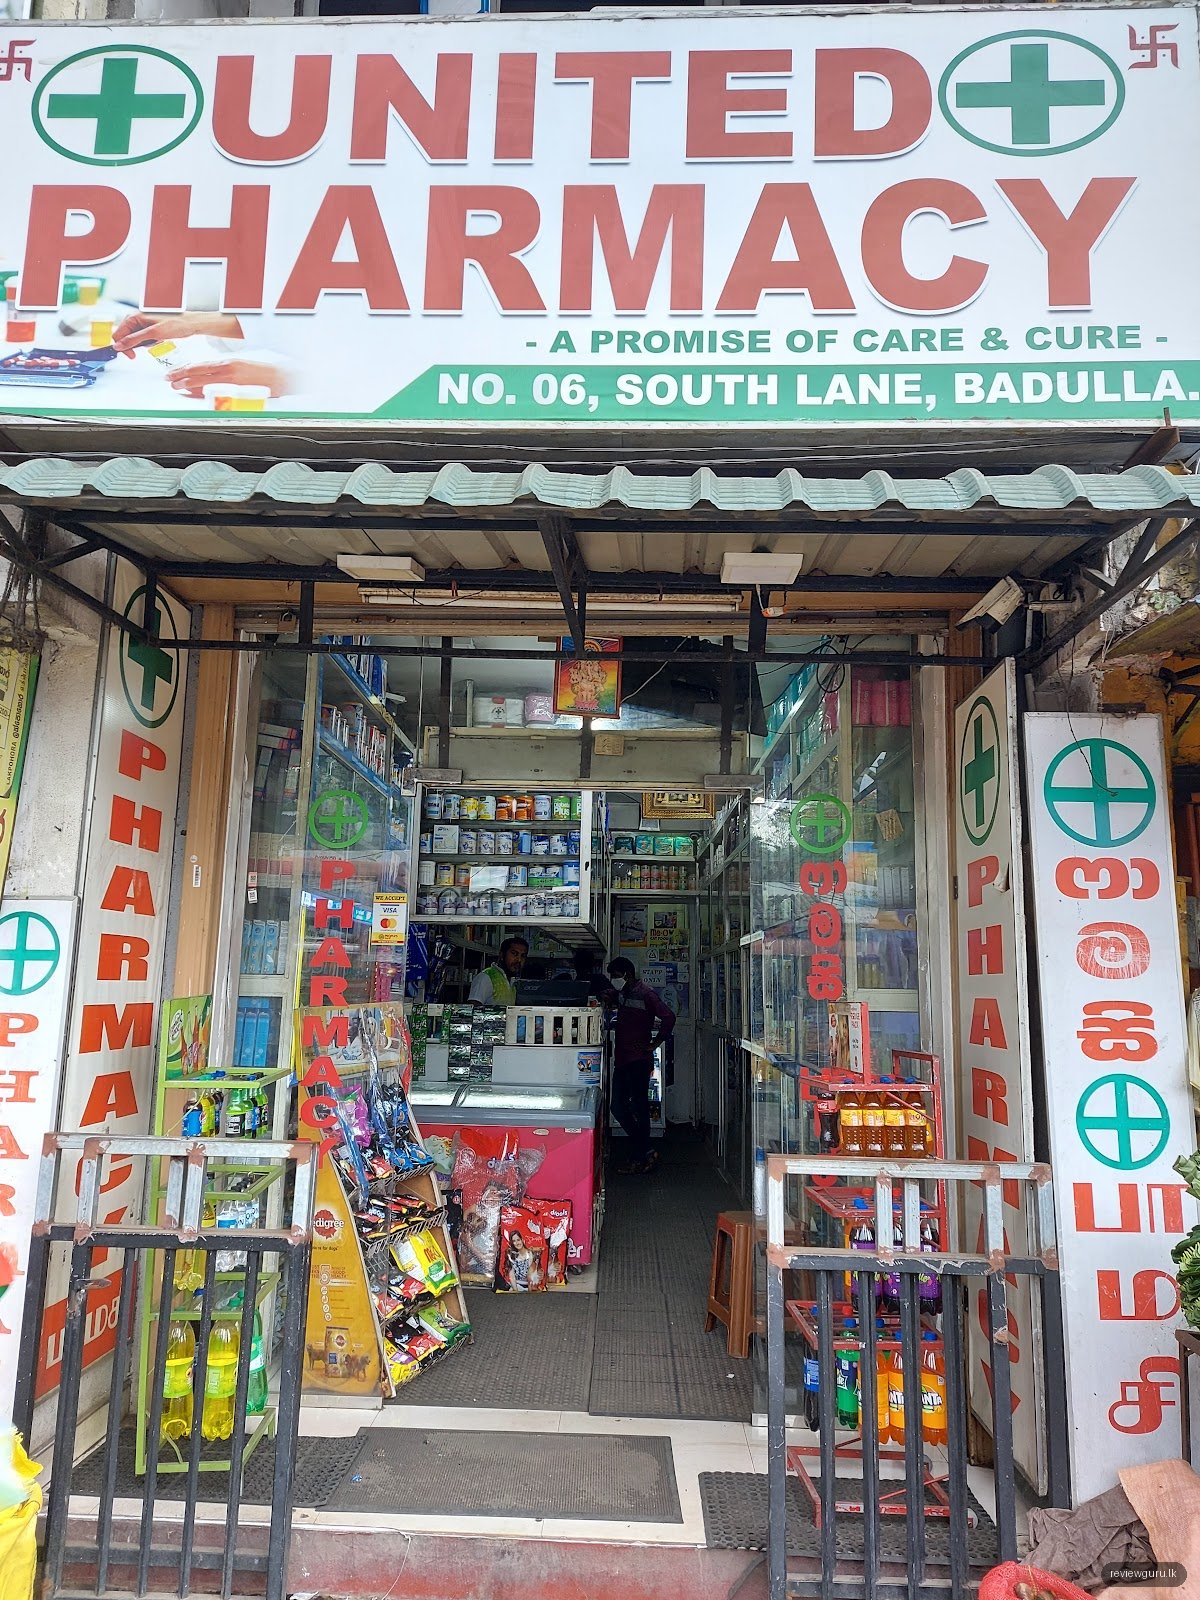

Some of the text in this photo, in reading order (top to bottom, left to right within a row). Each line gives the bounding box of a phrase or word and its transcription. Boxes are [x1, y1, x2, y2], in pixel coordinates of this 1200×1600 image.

[212, 47, 933, 163] UNITED
[19, 177, 1138, 312] PHARMACY
[550, 330, 577, 353] A
[591, 329, 772, 354] PROMISE
[785, 328, 838, 354] OF
[852, 327, 964, 353] CARE
[980, 326, 1009, 352] &
[1025, 325, 1141, 352] CURE
[437, 369, 1200, 412] NO. 06, SOUTH LANE, BADULLA.
[7, 741, 18, 785] LAKPOHORA
[313, 1217, 344, 1229] edigree
[550, 1208, 568, 1217] drools
